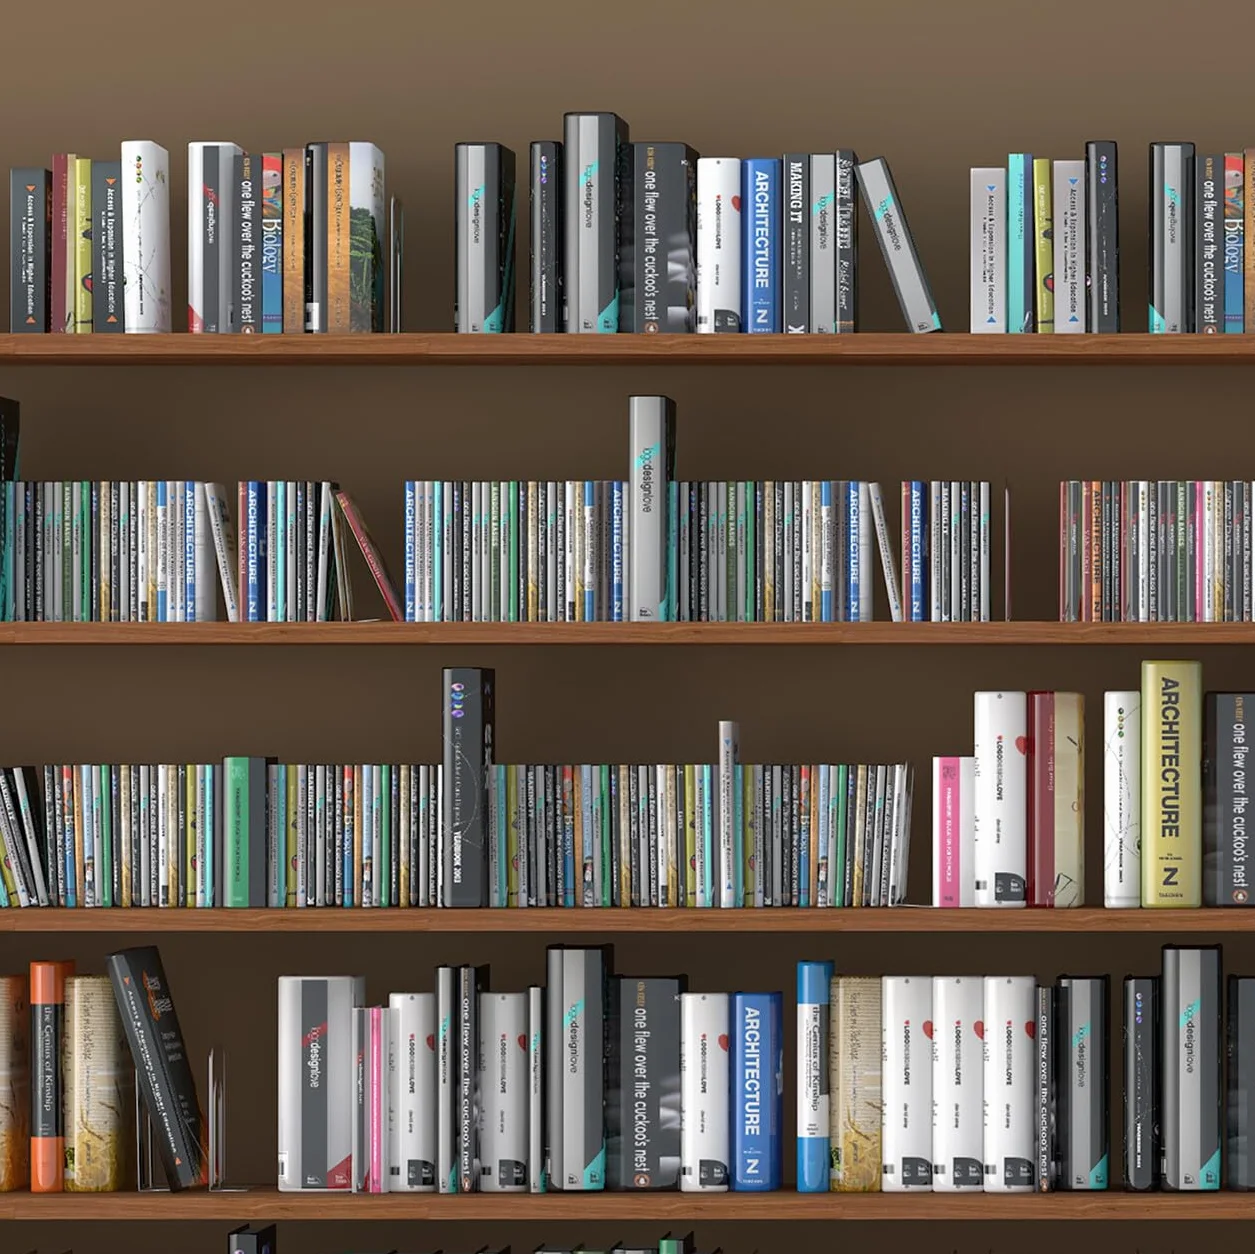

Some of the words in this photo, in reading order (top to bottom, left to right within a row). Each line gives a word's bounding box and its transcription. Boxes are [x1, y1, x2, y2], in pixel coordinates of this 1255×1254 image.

[241, 180, 252, 199] one
[790, 162, 802, 208] MAKING
[241, 200, 255, 220] flew
[790, 211, 802, 223] IT
[241, 221, 252, 242] over
[755, 171, 769, 288] ARCHITECTURE
[241, 244, 255, 259] the
[263, 219, 281, 273] Biology
[1225, 219, 1243, 273] Biology
[241, 261, 255, 301] cuckoo's
[241, 304, 255, 323] nest
[1233, 723, 1245, 744] one
[1161, 677, 1180, 838] ARCHITECTURE
[1233, 746, 1249, 768] flew
[1233, 770, 1245, 794] over
[1233, 797, 1249, 814] the
[1233, 816, 1249, 862] cuckoo's
[1233, 865, 1248, 887] nest
[44, 1007, 52, 1021] the
[634, 1008, 647, 1028] one
[44, 1025, 53, 1058] Genius
[634, 1031, 650, 1053] flew
[44, 1061, 53, 1072] of
[634, 1055, 647, 1079] over
[745, 1007, 760, 1135] ARCHITECTURE
[42, 1075, 53, 1111] Kinship
[634, 1082, 650, 1098] the
[634, 1101, 650, 1146] cuckoo's
[634, 1150, 650, 1172] nest
